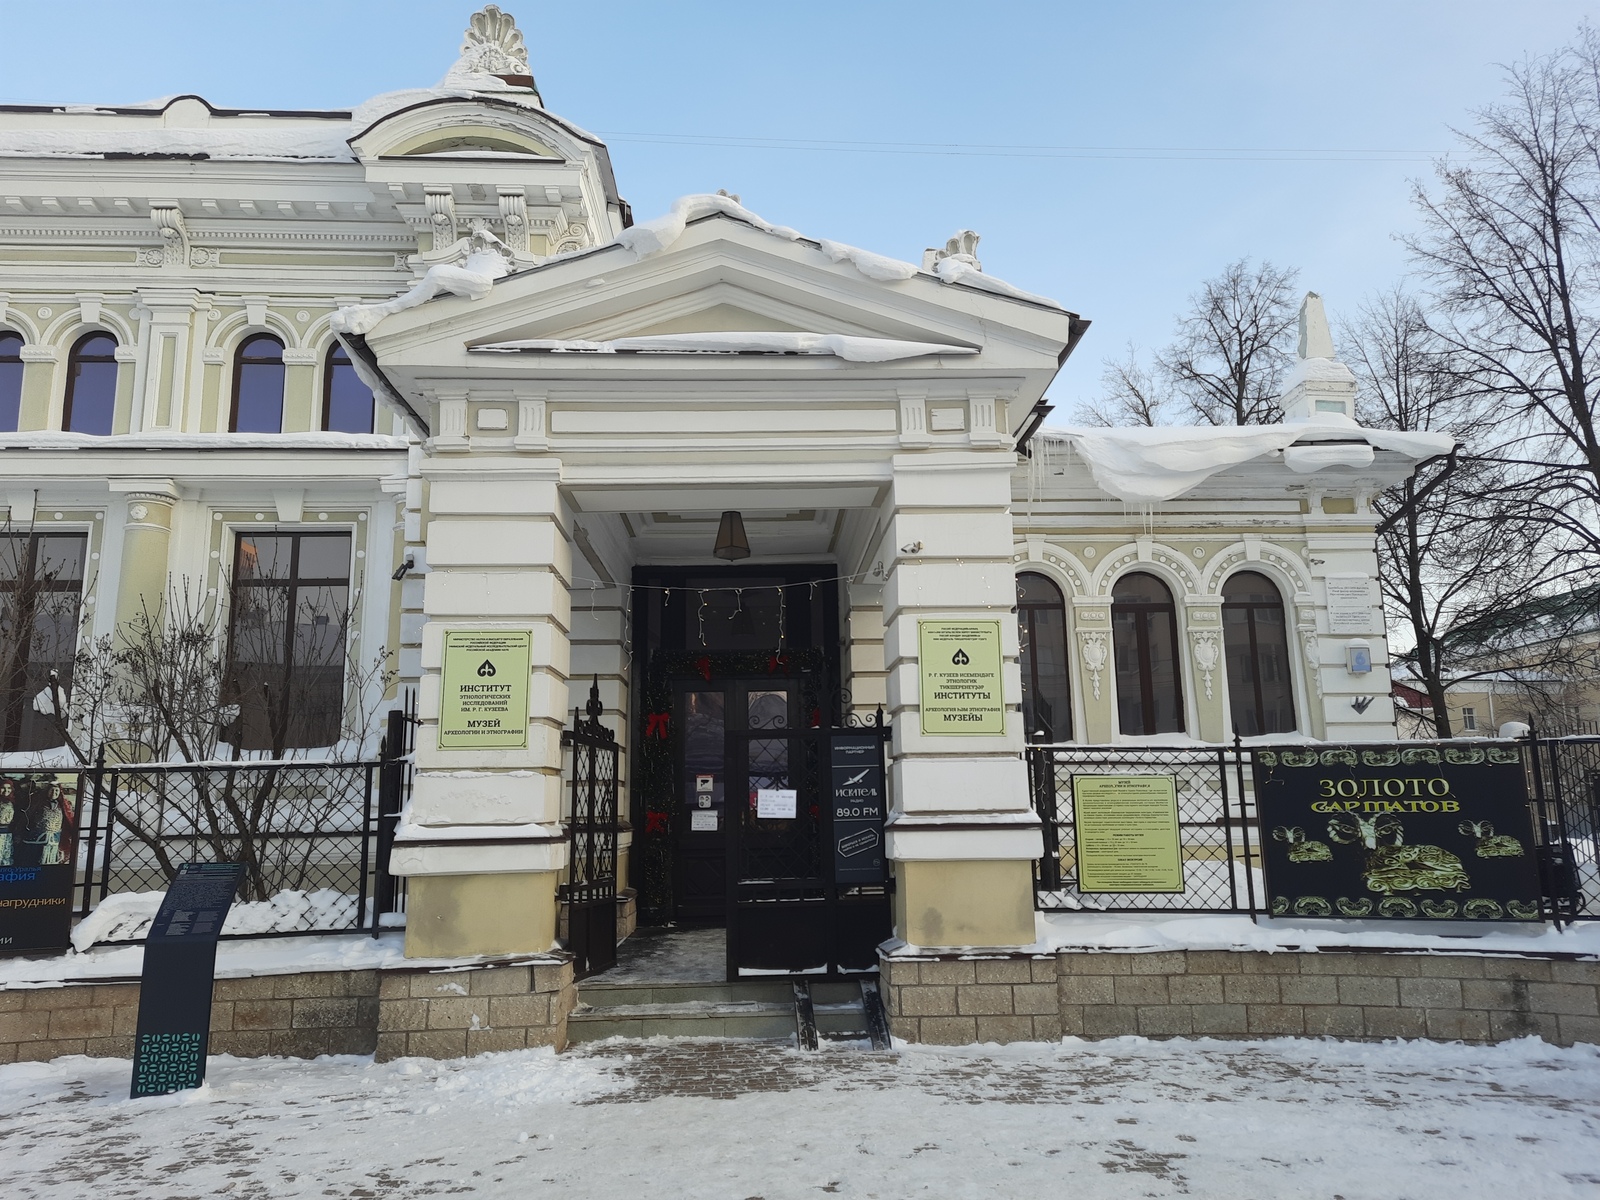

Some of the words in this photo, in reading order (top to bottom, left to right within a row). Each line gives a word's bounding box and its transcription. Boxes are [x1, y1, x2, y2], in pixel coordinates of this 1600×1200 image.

[1355, 652, 1366, 665] 6
[944, 713, 983, 721] МУЗЕЙЫ
[467, 719, 500, 727] МУЗЕЙ
[1319, 778, 1450, 797] ЗОЛОТО
[836, 808, 860, 817] 89.0
[863, 807, 878, 816] FM
[1311, 800, 1460, 813] САРМАТОВ
